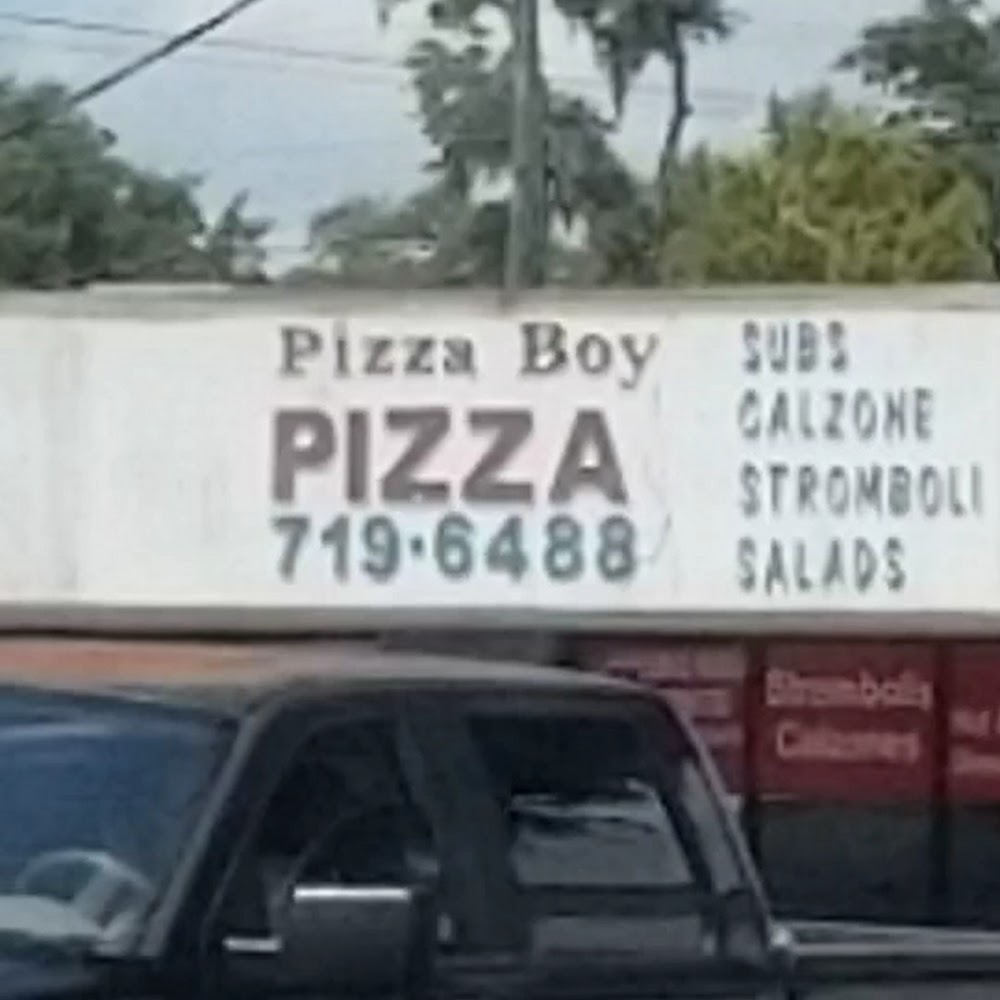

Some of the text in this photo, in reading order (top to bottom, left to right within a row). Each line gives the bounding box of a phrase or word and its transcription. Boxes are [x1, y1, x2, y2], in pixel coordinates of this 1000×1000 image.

[279, 320, 660, 390] Pizza Boy
[742, 319, 848, 374] SUBS
[737, 385, 934, 441] CALZONE
[272, 407, 630, 505] PIZZA
[739, 461, 983, 520] STROMBOLI
[737, 536, 907, 595] SALADS
